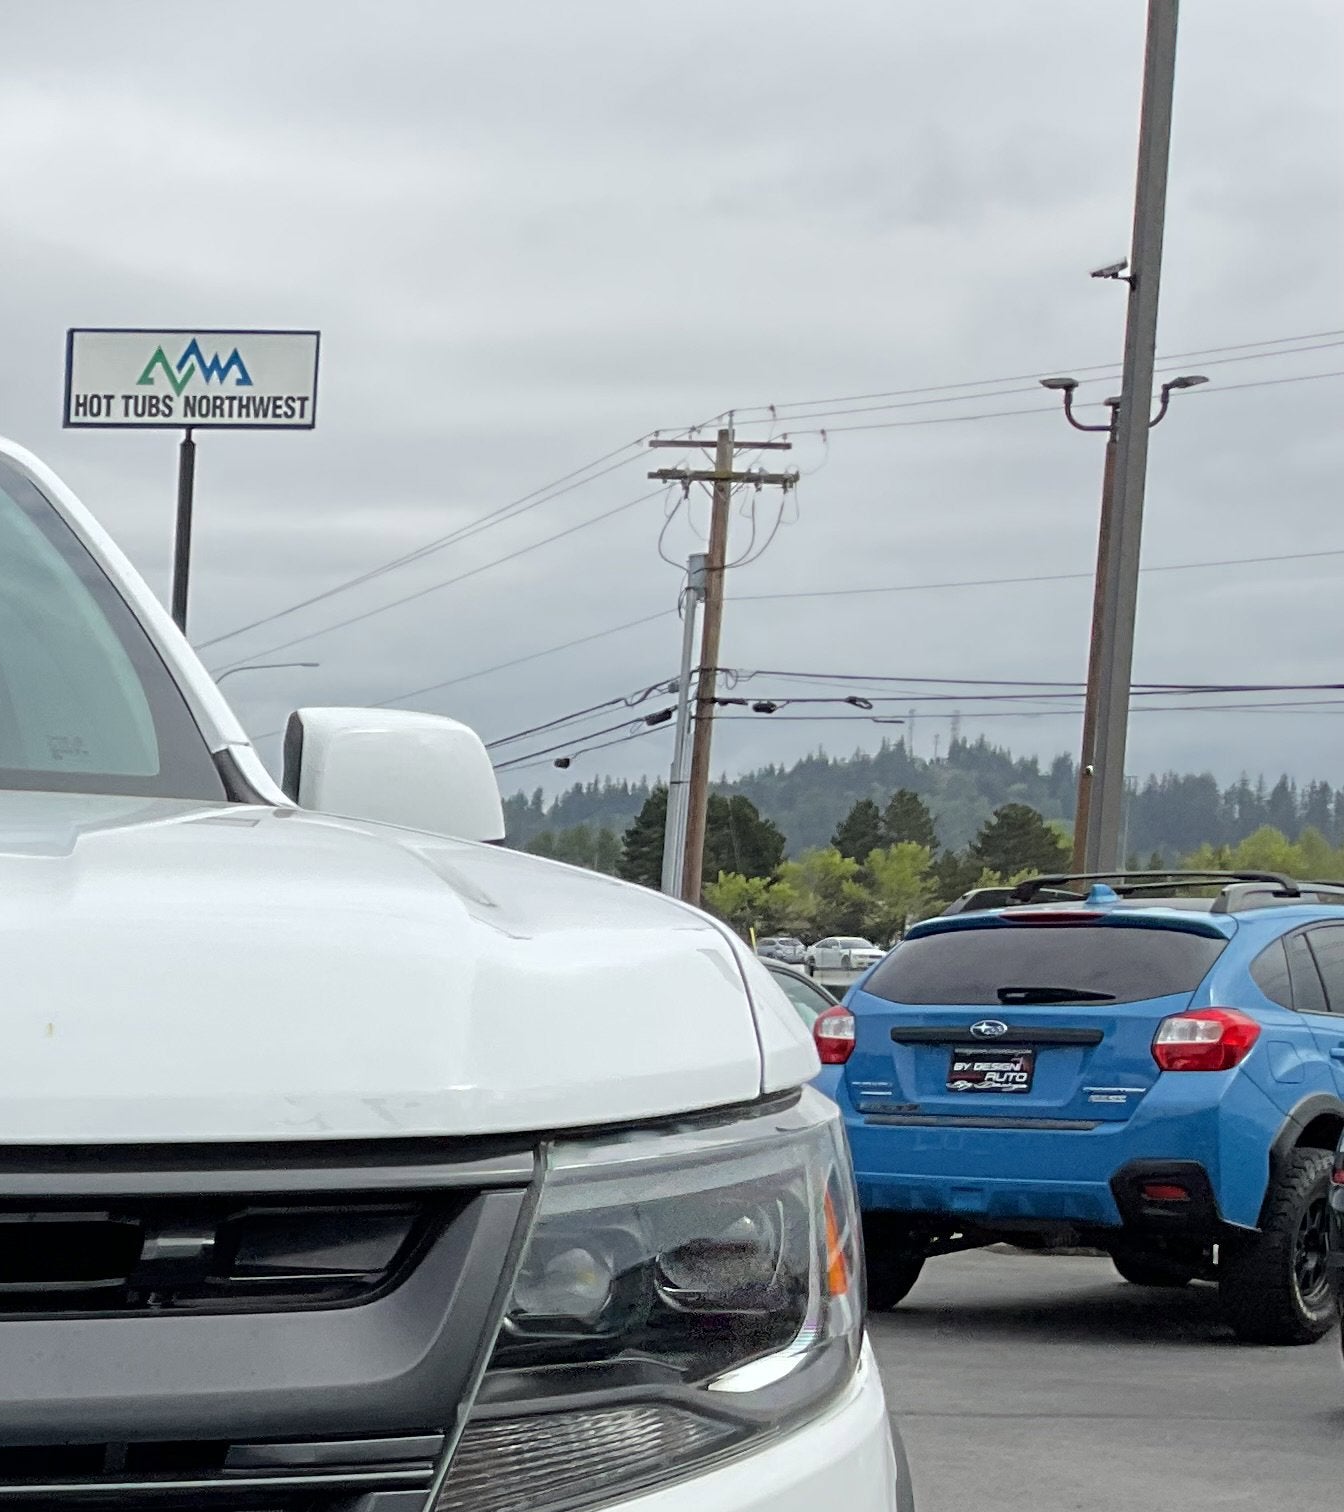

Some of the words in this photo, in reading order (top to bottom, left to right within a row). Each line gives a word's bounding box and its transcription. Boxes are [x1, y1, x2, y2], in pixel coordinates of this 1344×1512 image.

[74, 394, 115, 418] HOT
[121, 394, 174, 418] TUBS
[183, 395, 310, 419] NORTHWEST
[953, 1062, 971, 1071] BY
[973, 1062, 1021, 1071] DESIGN
[984, 1072, 1028, 1082] AUTO
